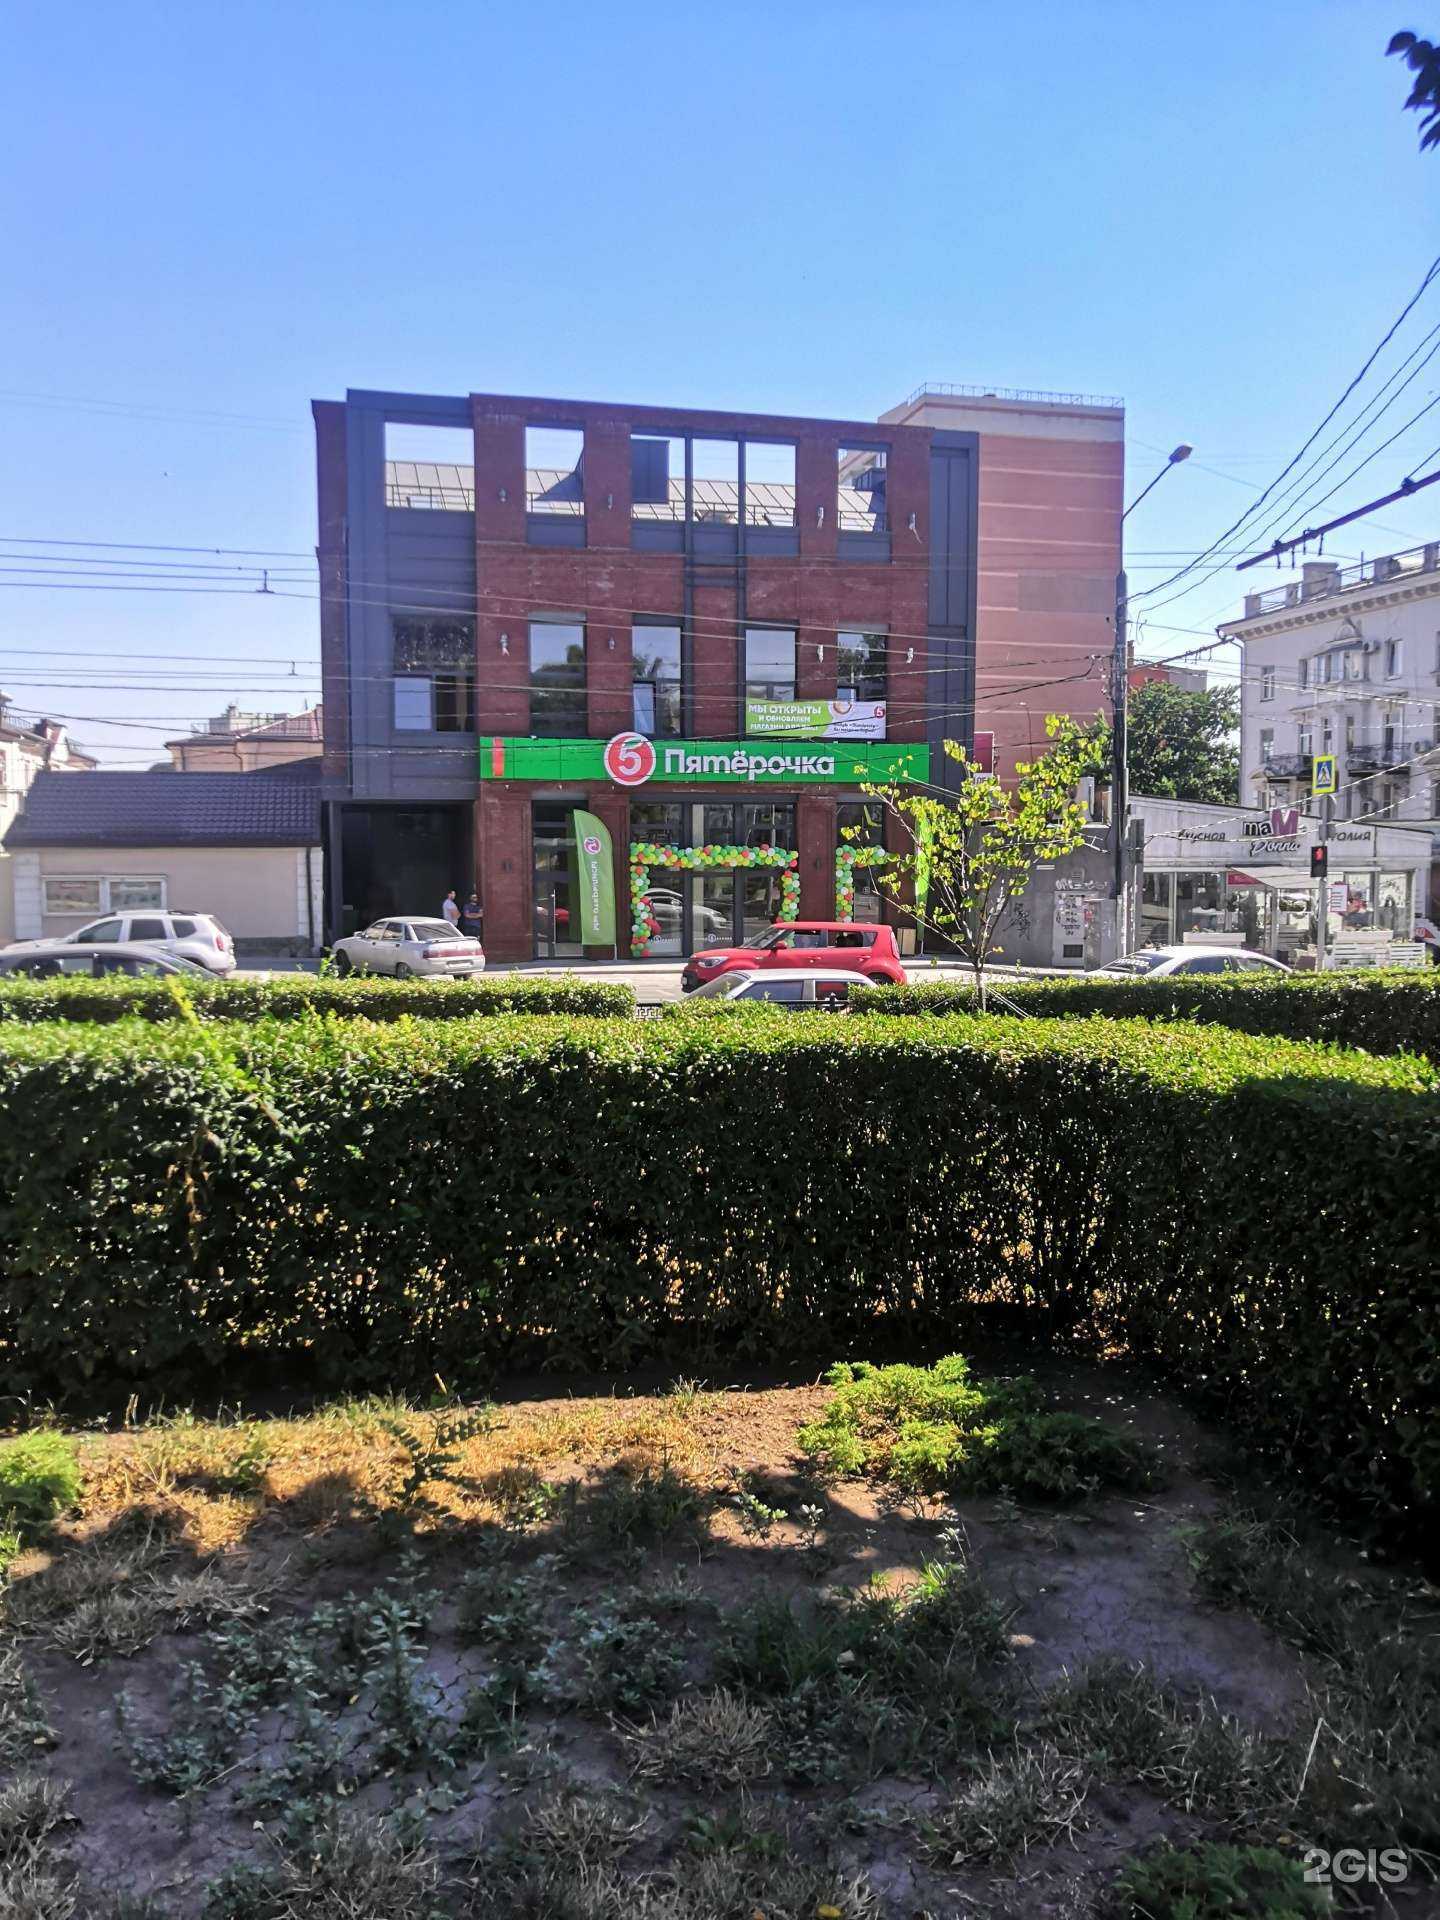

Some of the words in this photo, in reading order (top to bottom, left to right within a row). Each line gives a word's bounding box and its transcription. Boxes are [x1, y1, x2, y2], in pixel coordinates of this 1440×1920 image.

[748, 704, 767, 713] МЫ
[769, 705, 821, 714] ОТКРЫТЫ
[664, 749, 835, 781] Пятёрочка
